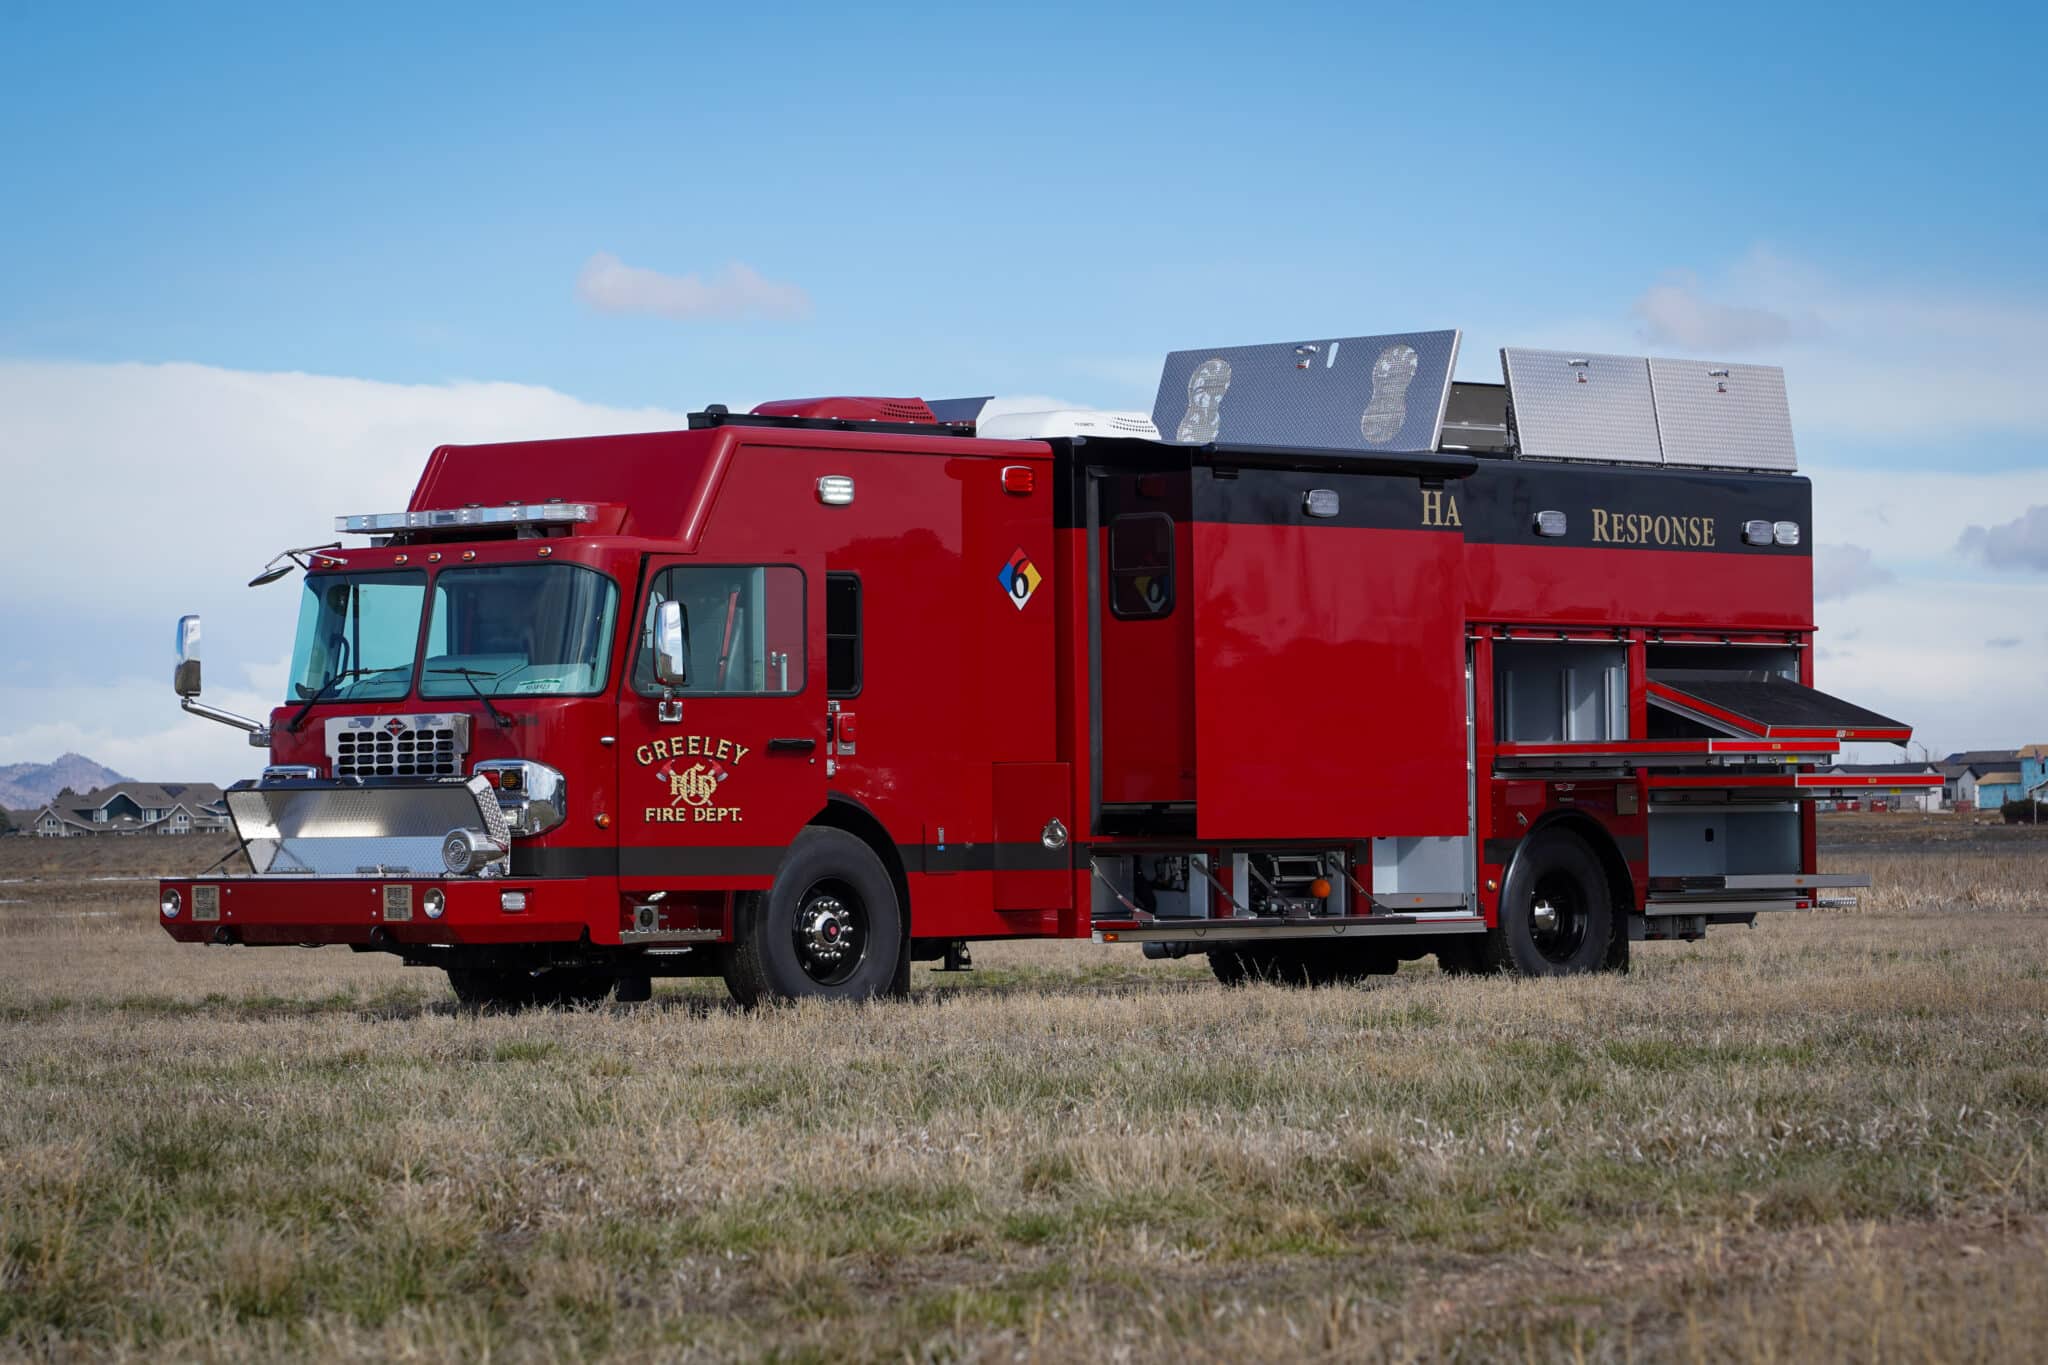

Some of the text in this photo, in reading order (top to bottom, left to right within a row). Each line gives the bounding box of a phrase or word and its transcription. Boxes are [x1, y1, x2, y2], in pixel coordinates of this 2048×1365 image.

[1591, 508, 1716, 547] RESPONSE
[1011, 558, 1029, 599] 6
[636, 736, 750, 765] GREELEY
[645, 807, 743, 822] FIRE DEPT.
